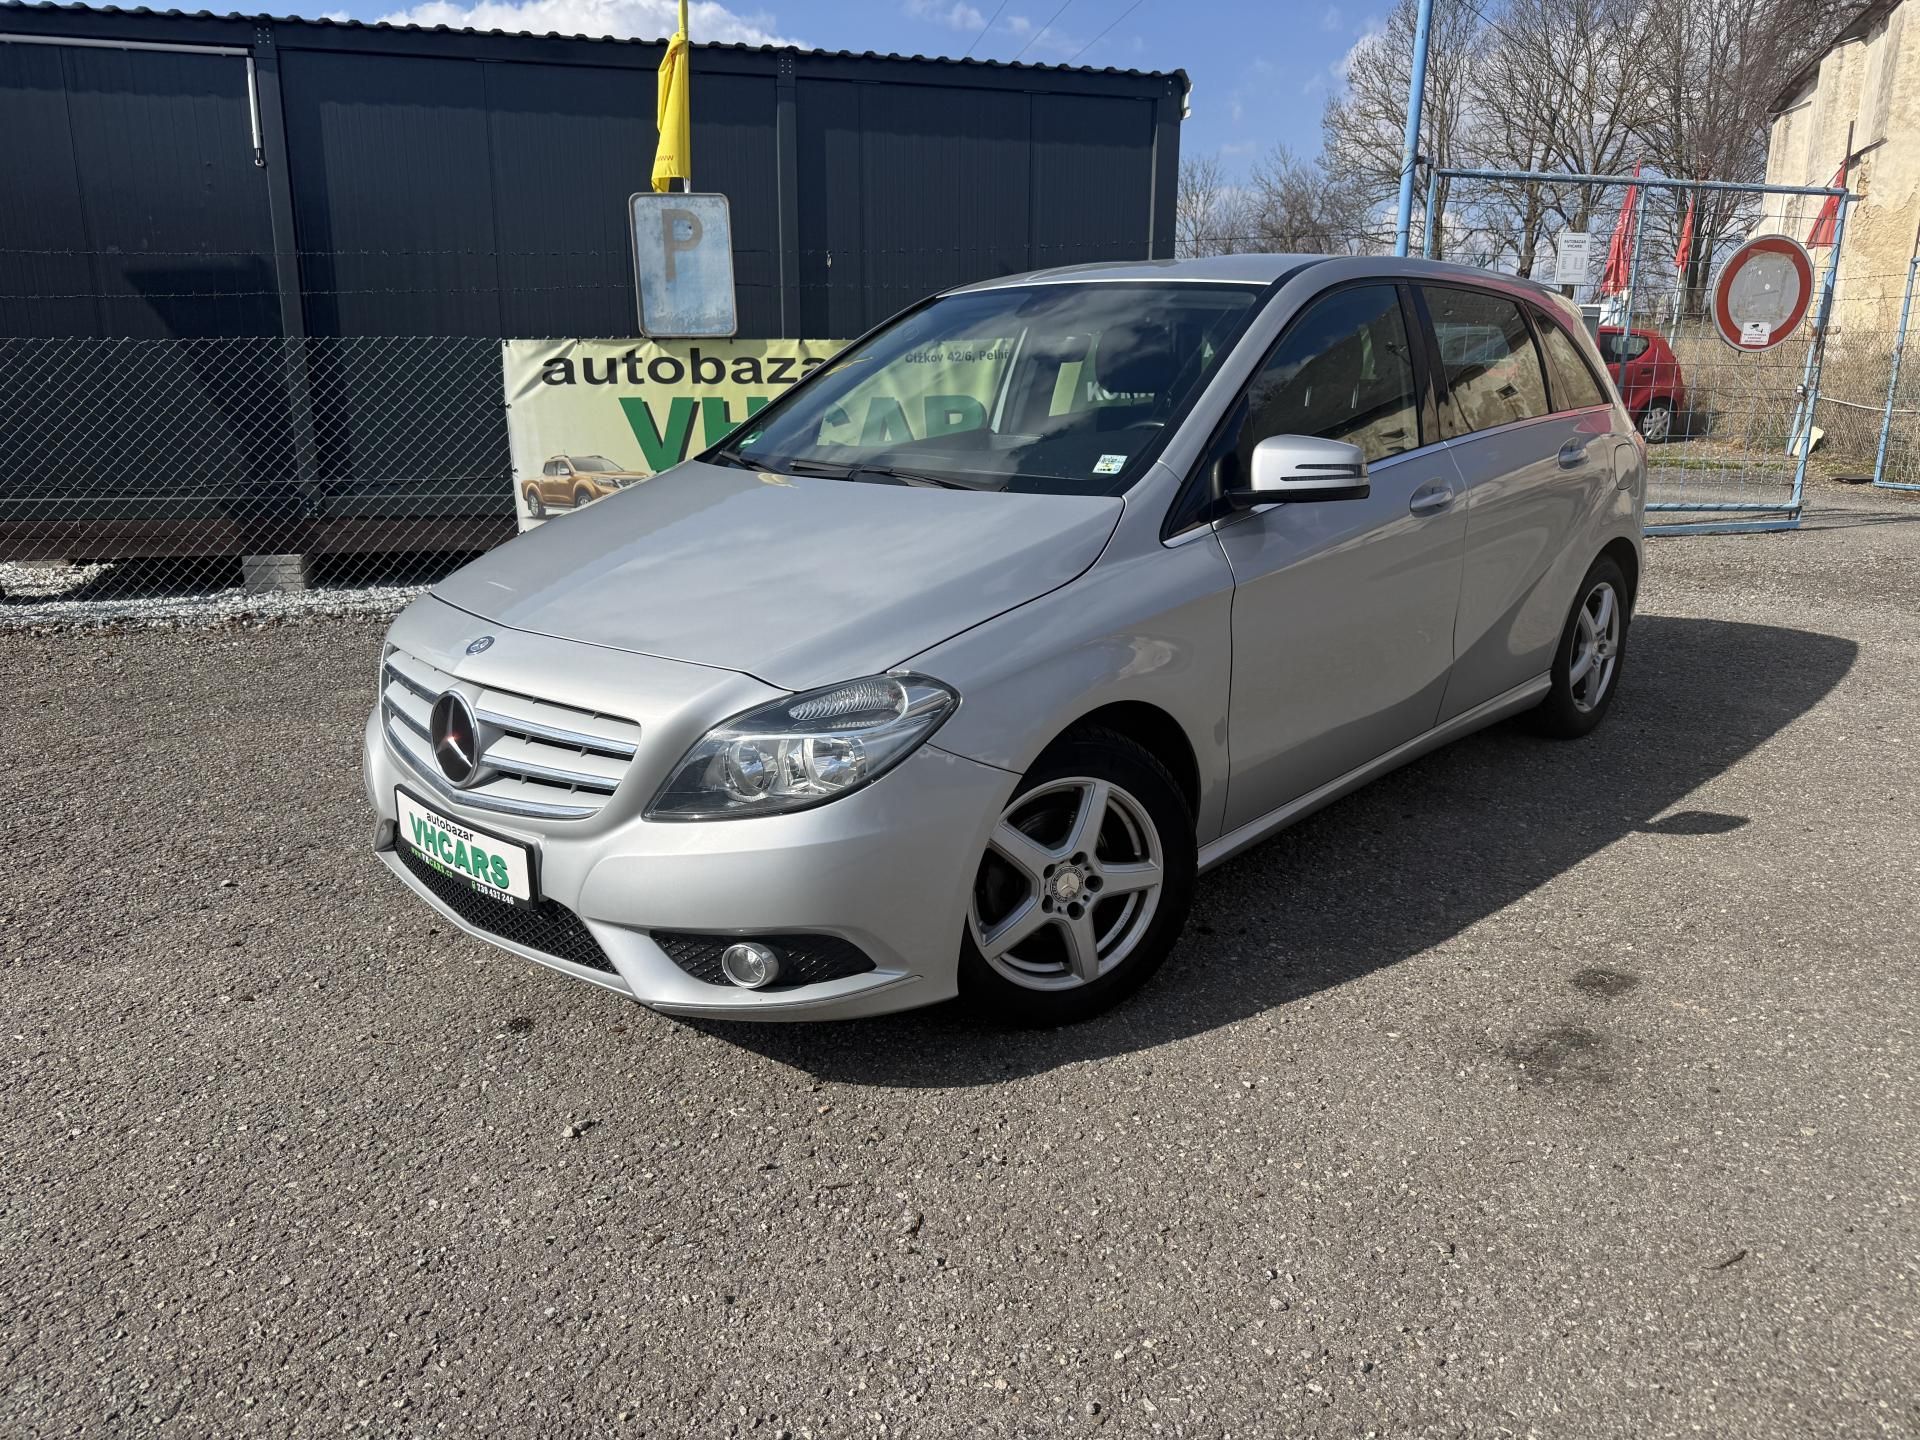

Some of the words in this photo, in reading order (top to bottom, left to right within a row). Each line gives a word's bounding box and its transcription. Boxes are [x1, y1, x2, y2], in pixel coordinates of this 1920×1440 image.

[661, 208, 704, 282] P
[409, 811, 510, 889] VHCARS
[426, 812, 474, 842] autobazar
